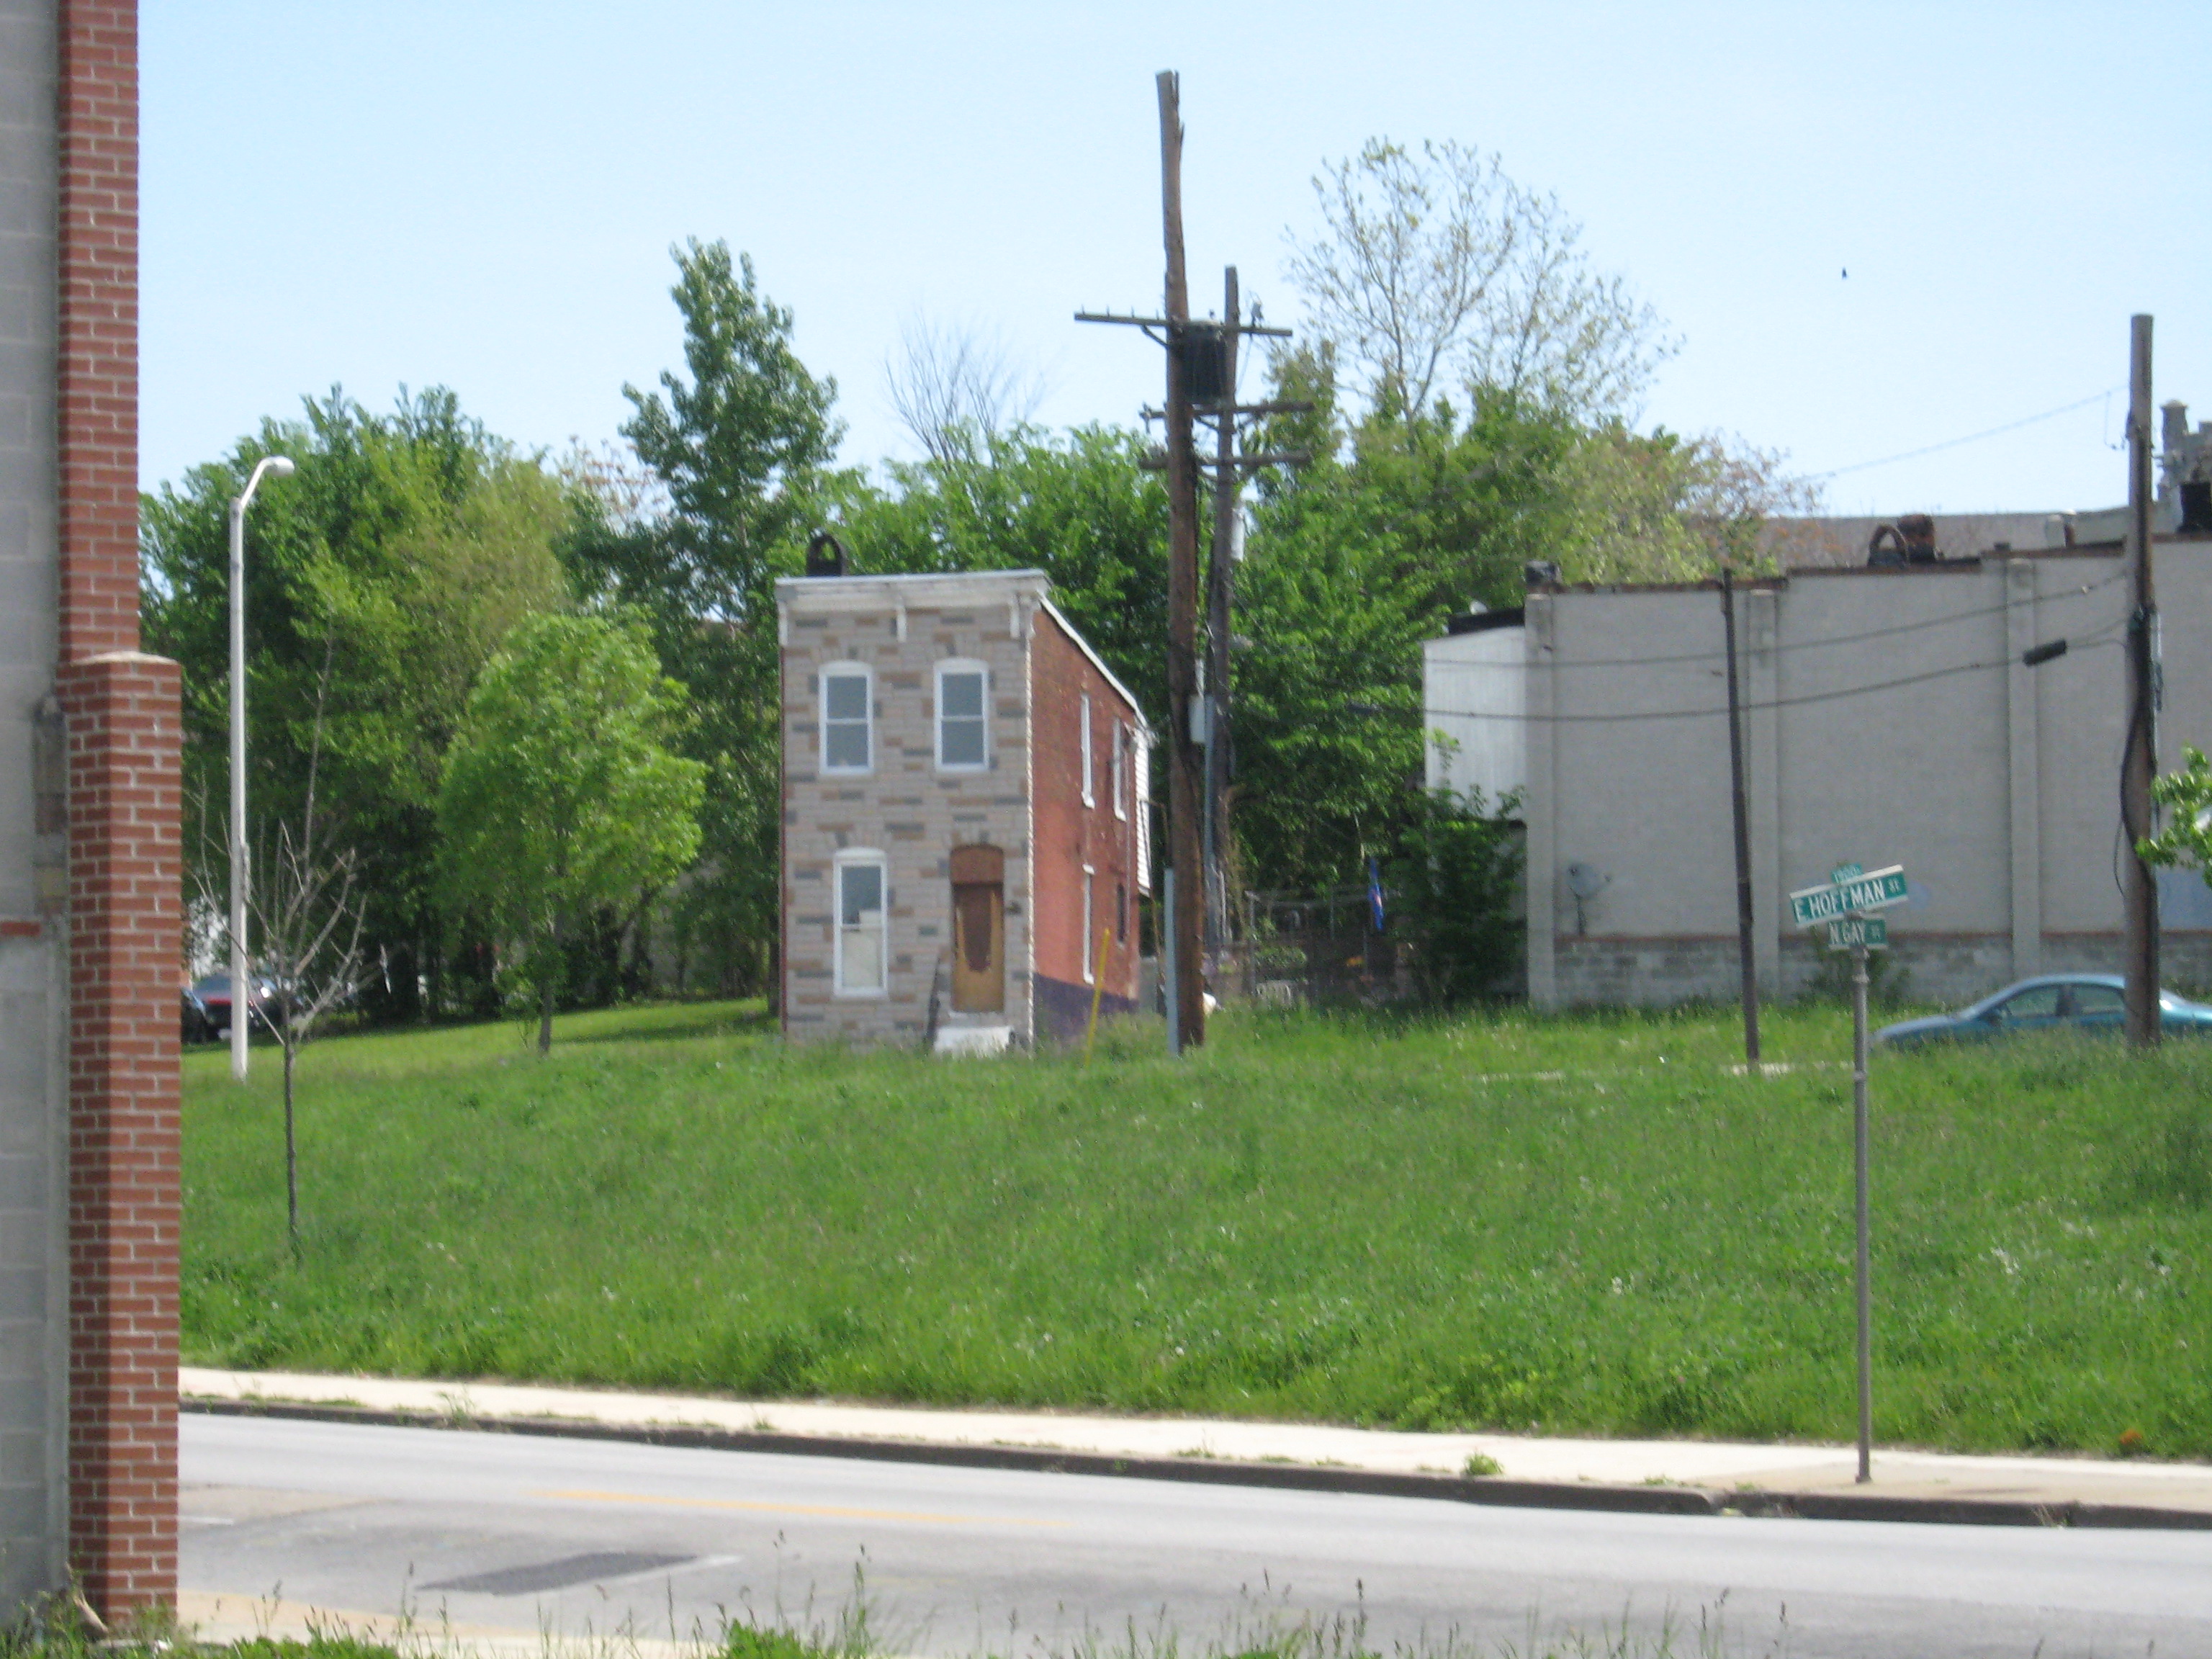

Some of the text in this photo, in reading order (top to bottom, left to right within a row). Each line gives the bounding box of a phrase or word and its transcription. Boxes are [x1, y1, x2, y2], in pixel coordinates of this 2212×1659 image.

[1808, 879, 1885, 920] HOFFMAN
[1829, 922, 1839, 945] N
[1842, 921, 1866, 945] GAY
